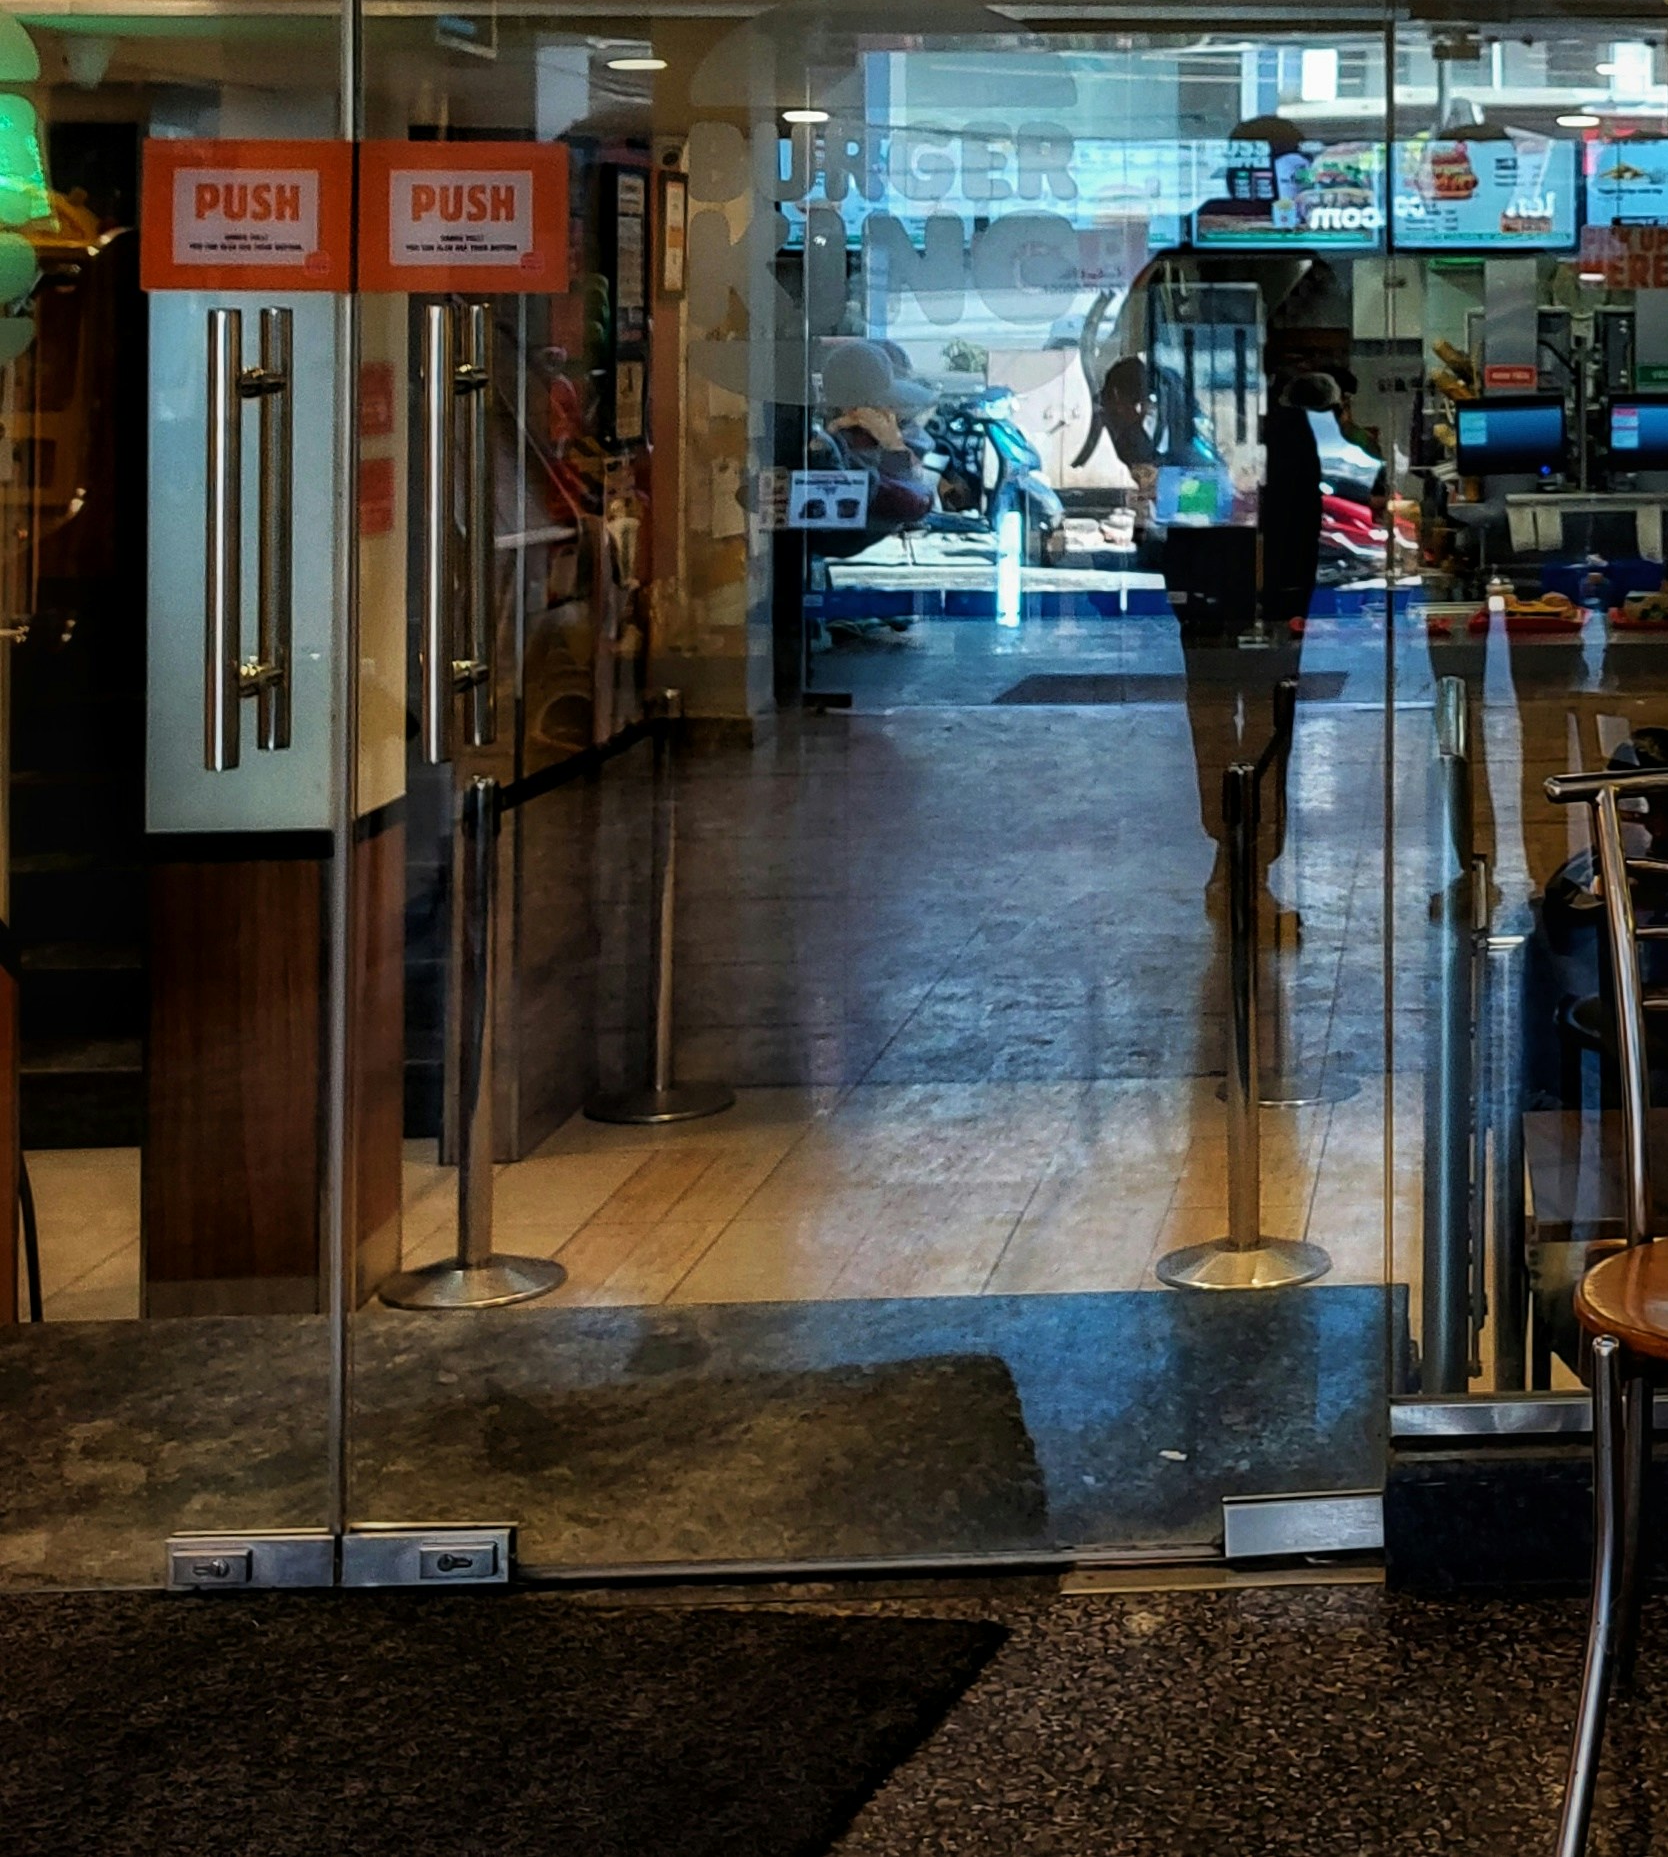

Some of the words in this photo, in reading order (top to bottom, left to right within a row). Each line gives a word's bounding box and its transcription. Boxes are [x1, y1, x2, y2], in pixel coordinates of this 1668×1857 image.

[687, 121, 1079, 203] BURGER
[194, 183, 300, 222] PUSH
[411, 184, 515, 223] PUSH
[687, 209, 1082, 326] KING
